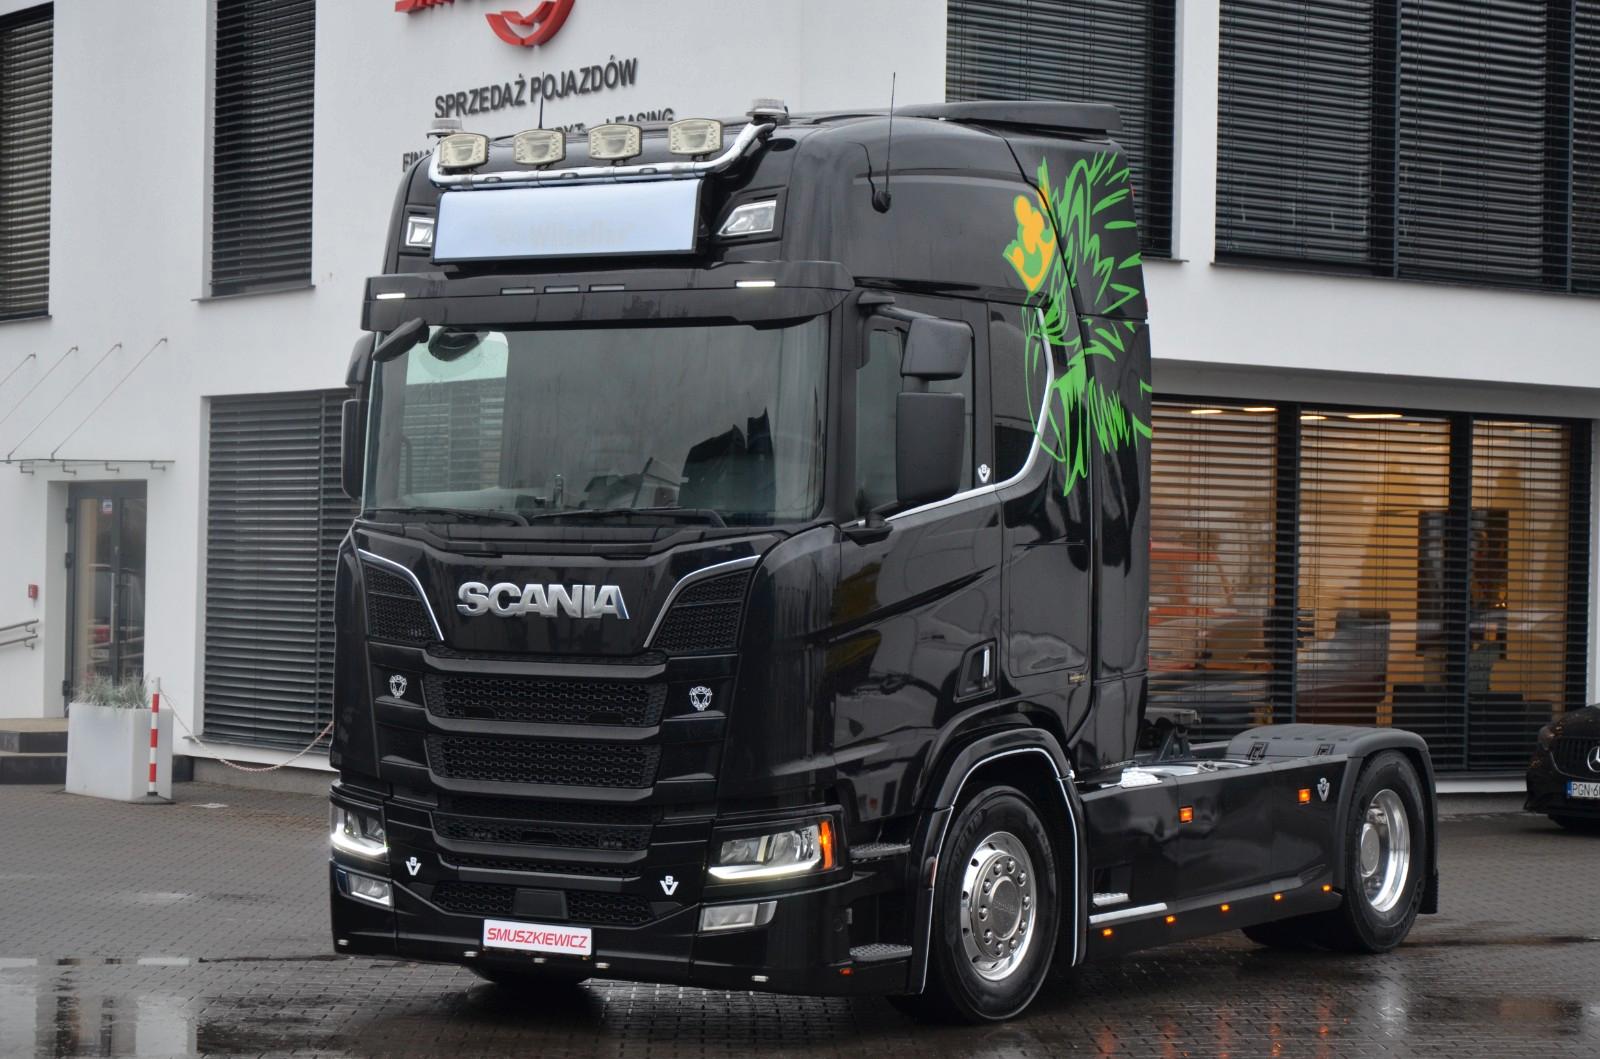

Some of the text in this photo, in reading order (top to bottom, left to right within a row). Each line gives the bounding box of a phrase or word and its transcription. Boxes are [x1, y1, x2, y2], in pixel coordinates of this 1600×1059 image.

[434, 55, 638, 119] SPRZEDAŻ POJAZDÓW
[457, 581, 630, 619] SCANIA
[487, 928, 588, 948] SMUSZKIEWICZ
